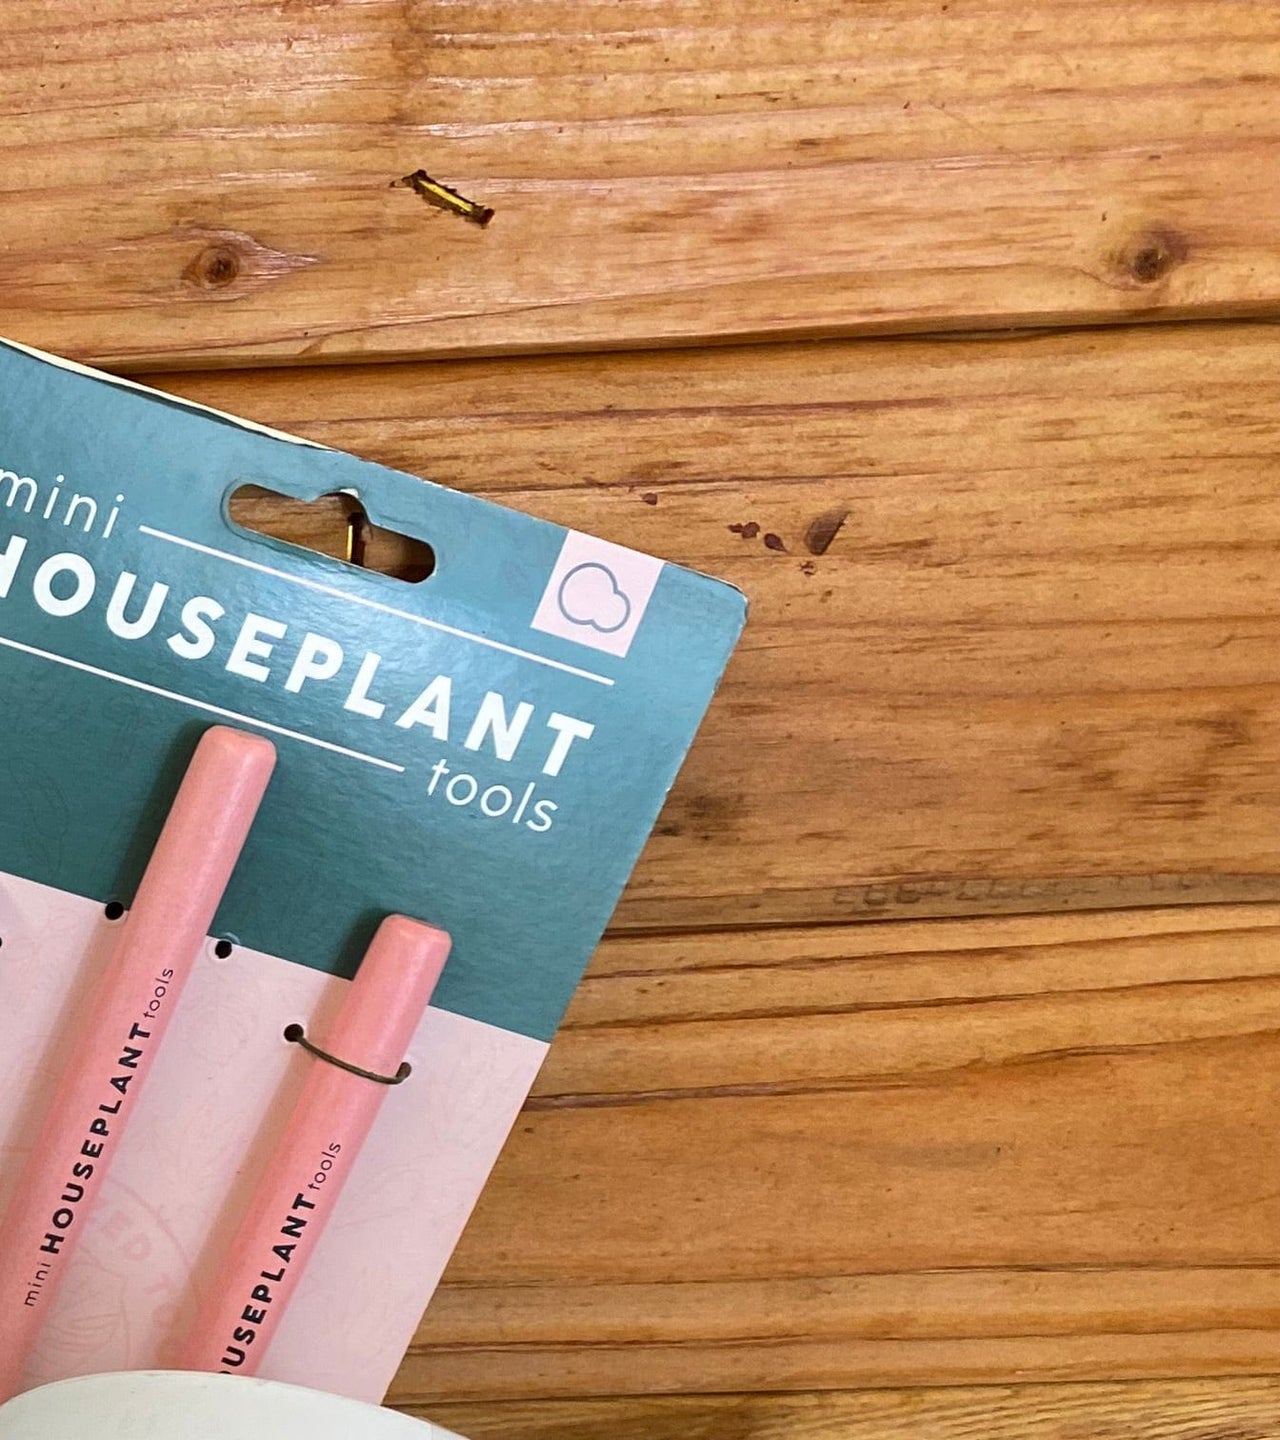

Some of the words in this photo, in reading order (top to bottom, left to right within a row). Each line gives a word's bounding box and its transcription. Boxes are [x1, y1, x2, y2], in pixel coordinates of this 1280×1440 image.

[427, 759, 559, 834] tools
[24, 1262, 51, 1307] mini
[39, 1022, 151, 1254] HOUSEPLANT
[143, 967, 174, 1018] tools
[218, 1193, 315, 1374] USEPLANT
[308, 1142, 341, 1190] tools
